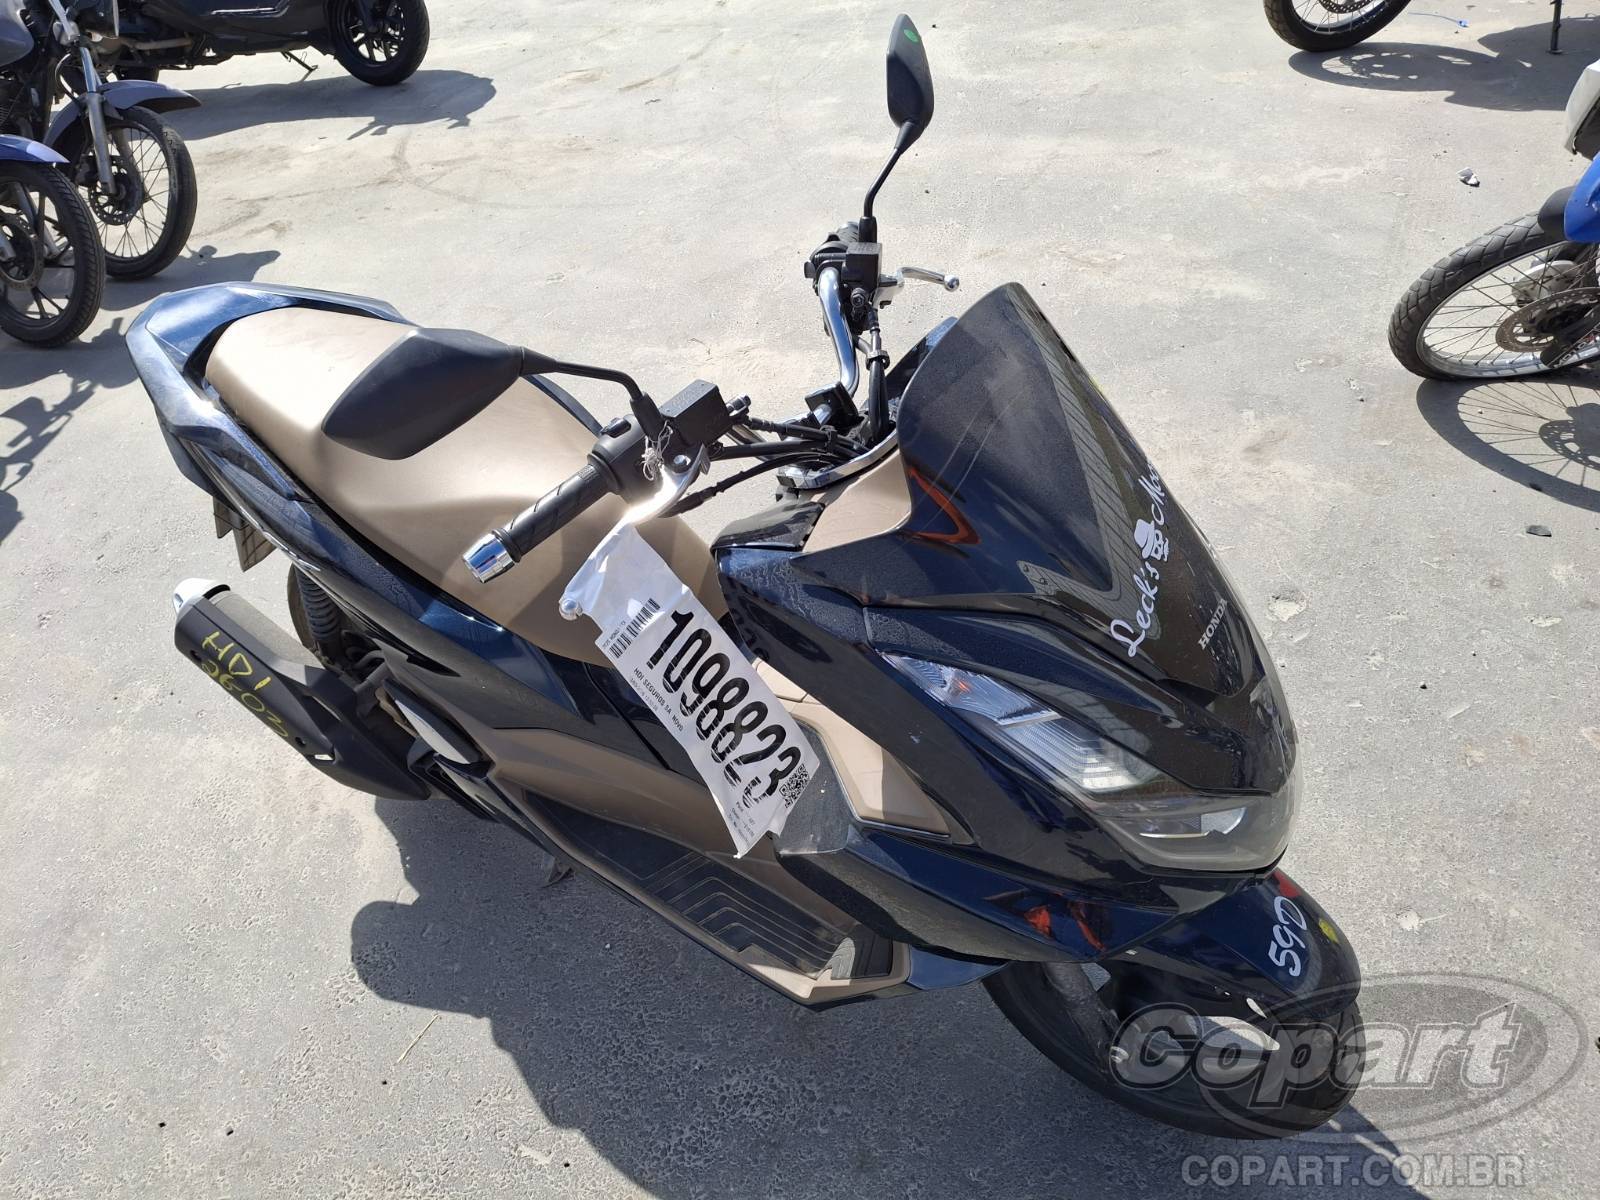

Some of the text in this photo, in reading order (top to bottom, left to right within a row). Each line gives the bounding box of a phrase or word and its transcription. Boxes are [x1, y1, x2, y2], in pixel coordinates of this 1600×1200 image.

[1198, 599, 1228, 650] HONDA
[202, 631, 272, 691] HDI
[642, 679, 666, 706] SEGUROS
[646, 610, 802, 808] 1098823
